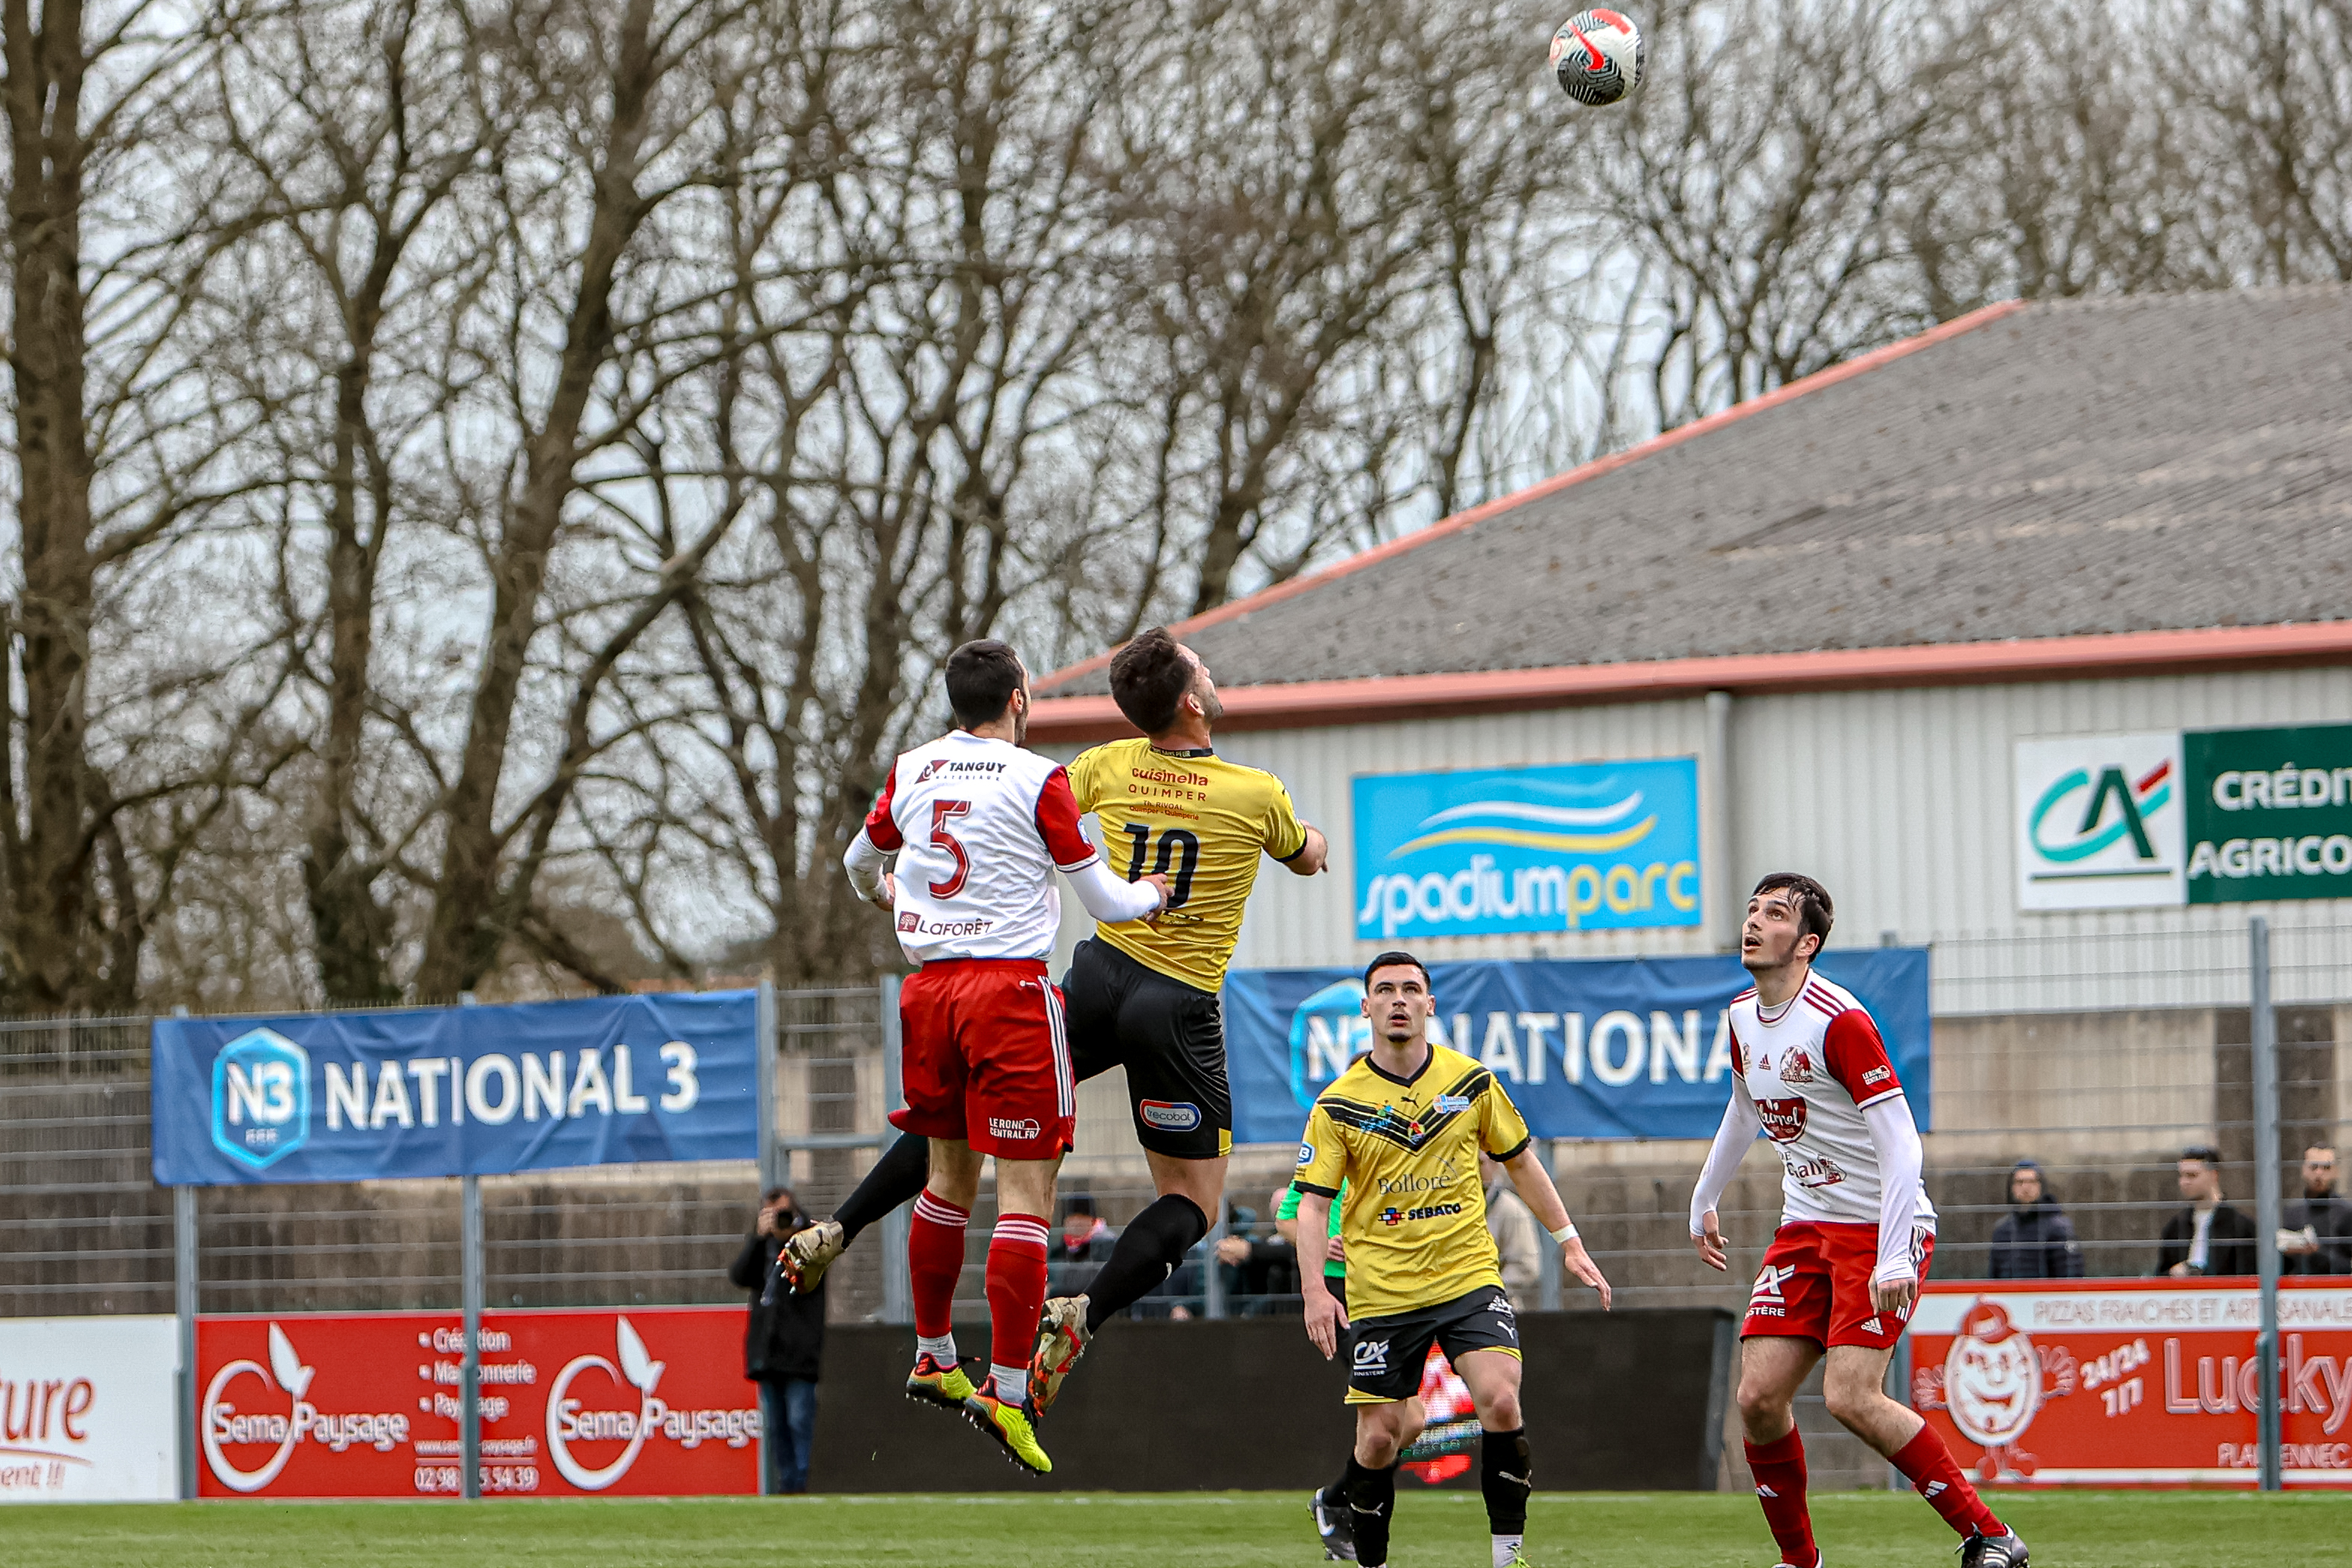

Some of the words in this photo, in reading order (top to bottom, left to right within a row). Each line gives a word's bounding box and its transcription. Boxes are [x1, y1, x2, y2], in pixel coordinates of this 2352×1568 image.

[950, 762, 1007, 774] TANGUY
[1132, 768, 1208, 786] cuisinella
[1128, 784, 1206, 801] QUIMPER
[928, 799, 971, 900] 5
[1124, 823, 1199, 908] 10
[227, 1061, 295, 1126] N3
[324, 1044, 650, 1132] NATIONAL
[659, 1040, 699, 1114] 3
[1147, 1109, 1190, 1121] trecobat
[989, 1127, 1035, 1139] CENTRAL.FR
[1408, 1202, 1462, 1221] SEBACO
[2033, 1299, 2096, 1324] PIZZAS
[0, 1375, 97, 1445] ure
[433, 1391, 510, 1423] Payage
[213, 1402, 289, 1444] Sema
[292, 1402, 411, 1453] Paysage
[557, 1398, 640, 1442] Sema
[642, 1396, 765, 1449] Paysage
[2217, 1441, 2351, 1469] PLAENNEC
[414, 1466, 437, 1492] 02
